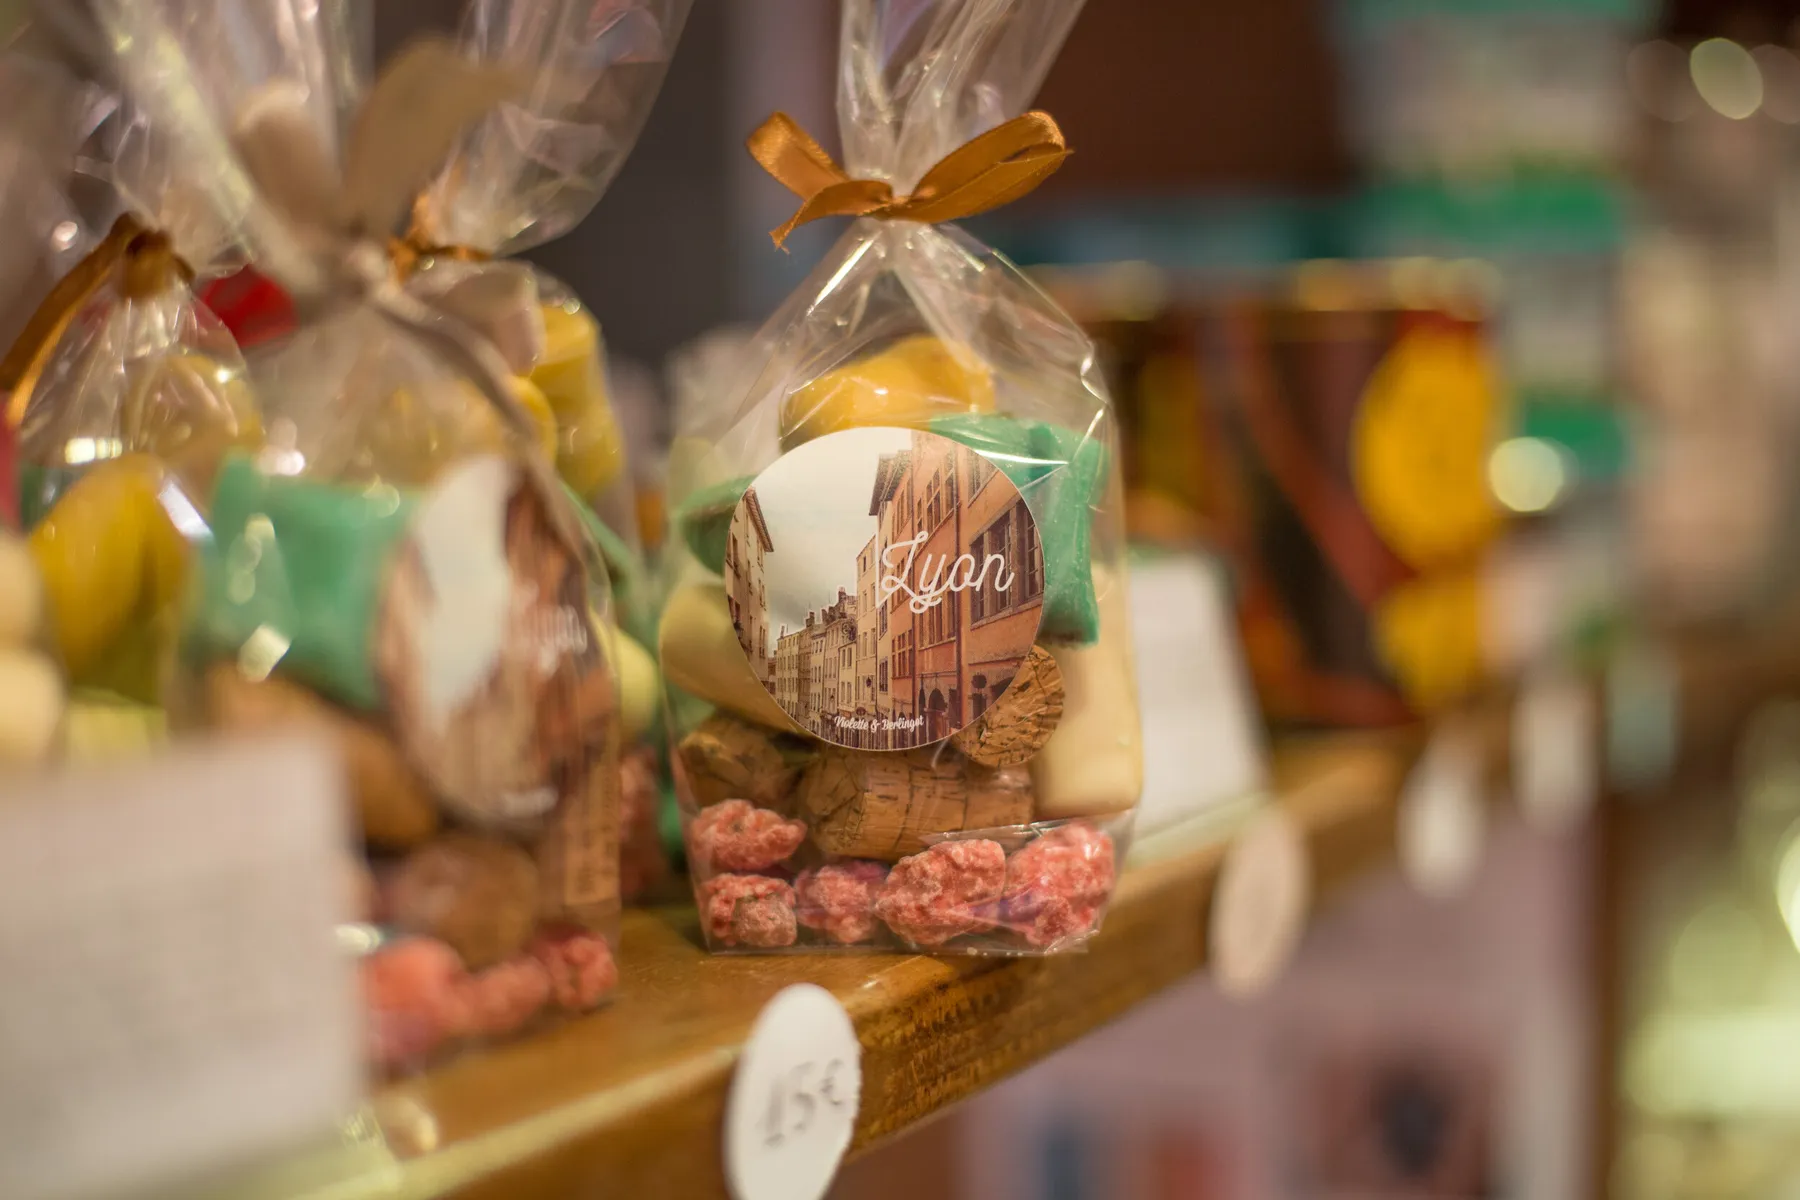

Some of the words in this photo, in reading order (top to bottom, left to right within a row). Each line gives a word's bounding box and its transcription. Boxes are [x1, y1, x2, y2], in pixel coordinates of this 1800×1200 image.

[878, 530, 1015, 614] Lyon
[834, 715, 869, 731] Violette
[870, 717, 880, 733] &
[881, 714, 925, 733] Berlingot
